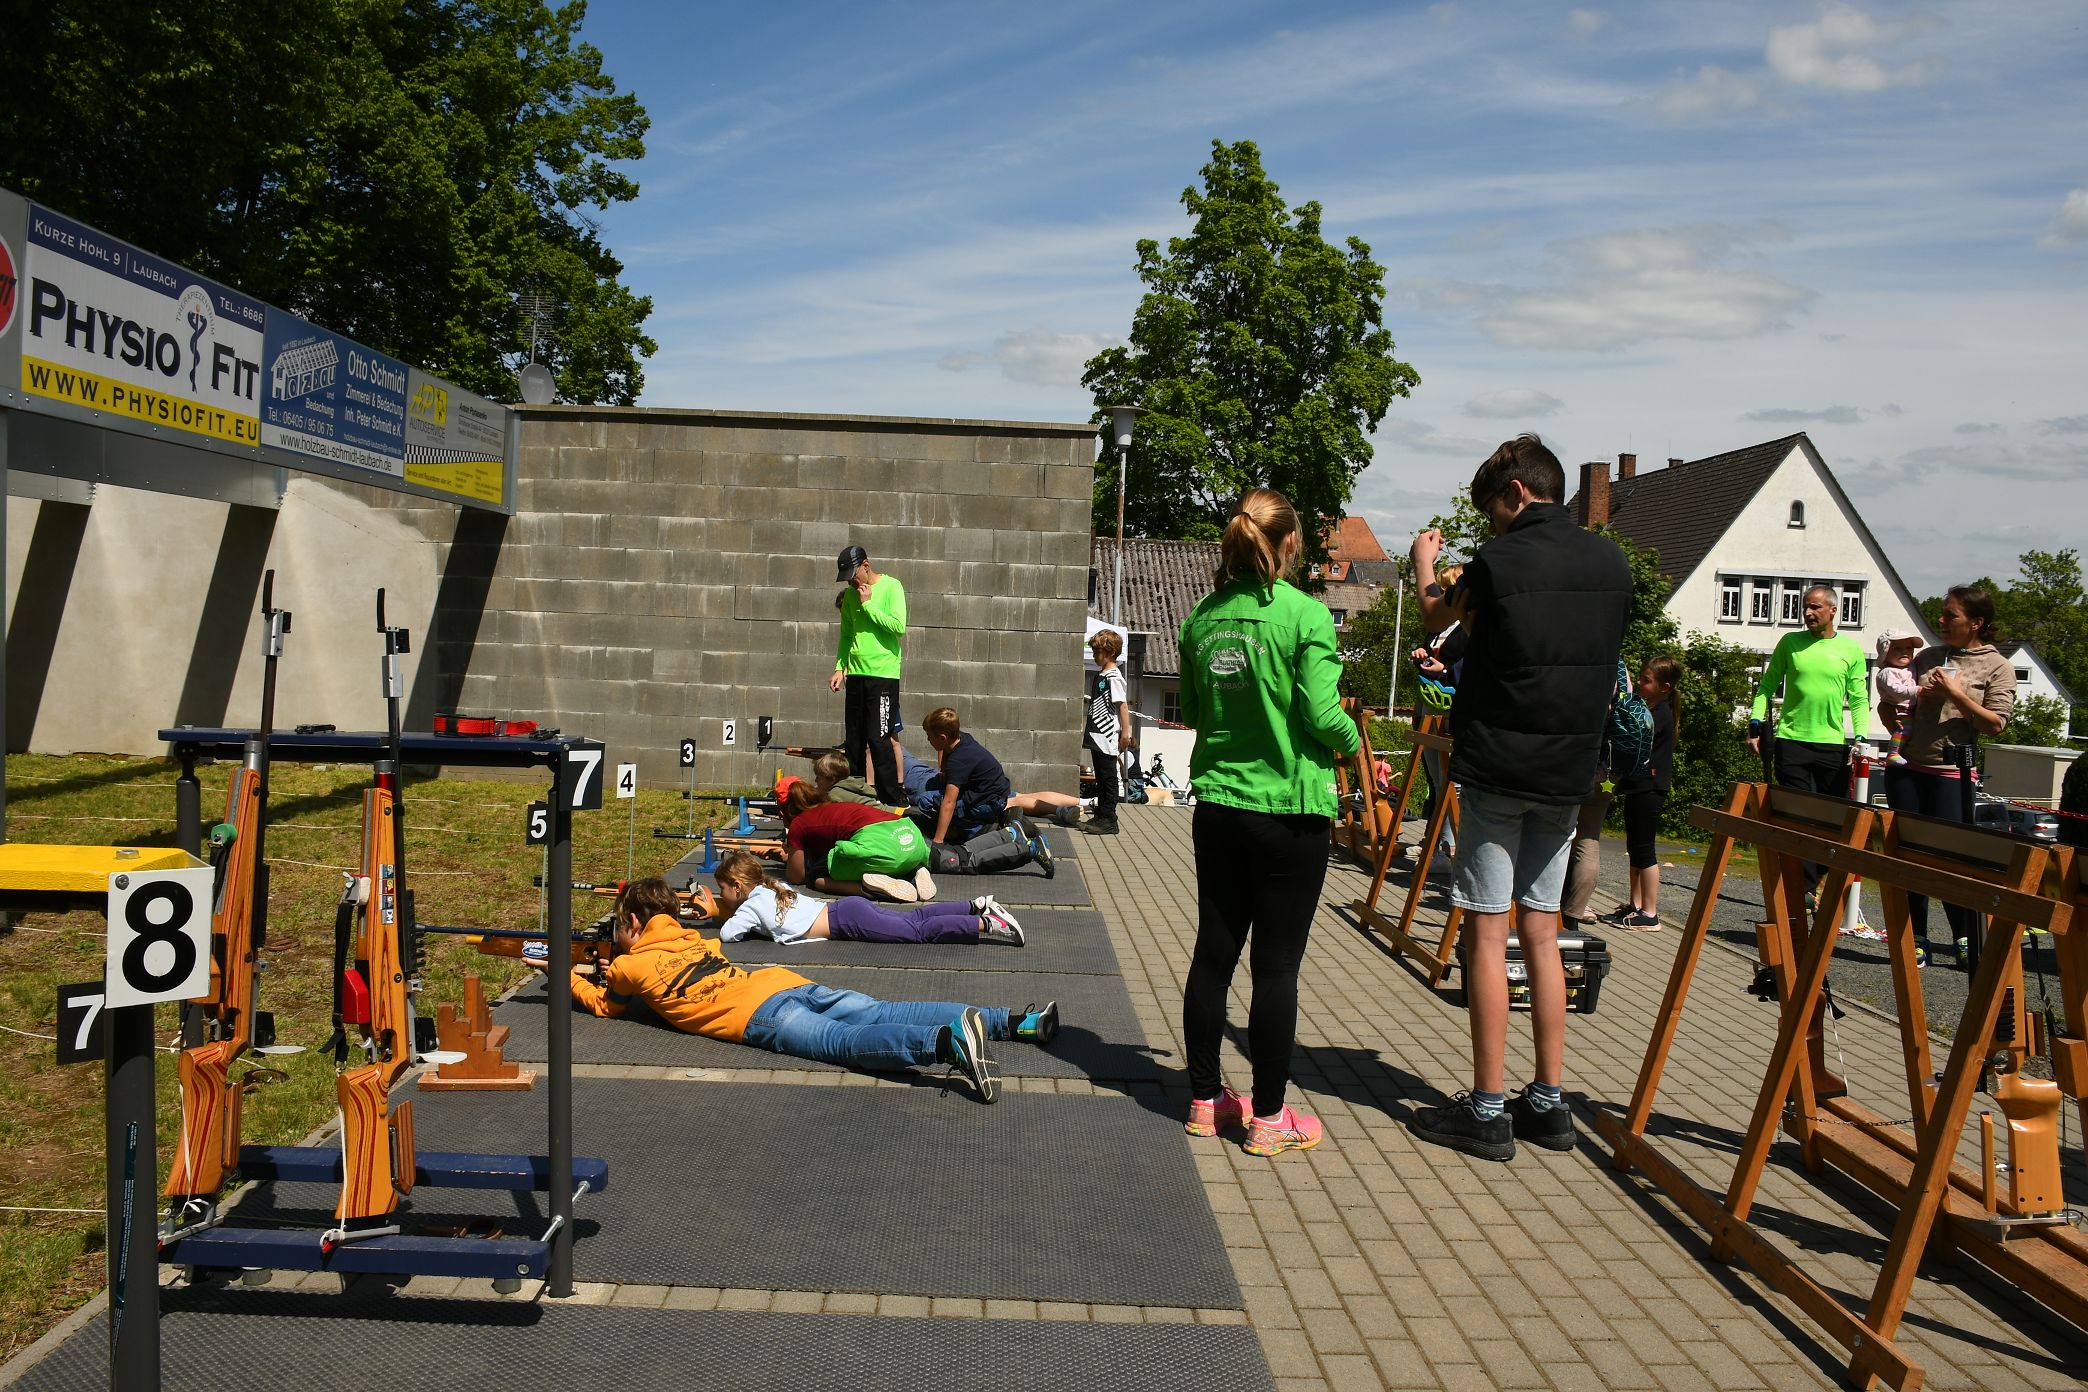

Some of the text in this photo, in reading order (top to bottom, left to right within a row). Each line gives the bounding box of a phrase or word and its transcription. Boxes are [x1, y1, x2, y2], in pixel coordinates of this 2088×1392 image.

[35, 219, 121, 266] KURZE HOHL 9
[133, 261, 177, 289] LAUBACH
[243, 306, 264, 324] 6686
[29, 277, 181, 378] PHYSIO
[211, 341, 260, 400] FIT
[348, 350, 405, 395] Otto Schmidt
[28, 363, 258, 441] WWW.PHYSIOFIT.EU
[306, 398, 334, 418] Bedachung
[346, 384, 404, 420] Zimmerei & Bedachung
[308, 418, 316, 432] 95
[326, 424, 334, 436] 75
[356, 410, 372, 427] Peter
[372, 415, 392, 434] Schmidt
[280, 434, 392, 472] www.holzbau-schmidt-laubach.de
[726, 724, 734, 741] 2
[765, 720, 771, 734] 1
[682, 743, 694, 764] 3
[568, 750, 602, 807] 7
[620, 770, 634, 792] 4
[530, 809, 548, 840] 5
[122, 880, 196, 994] 8
[67, 994, 104, 1050] 7
